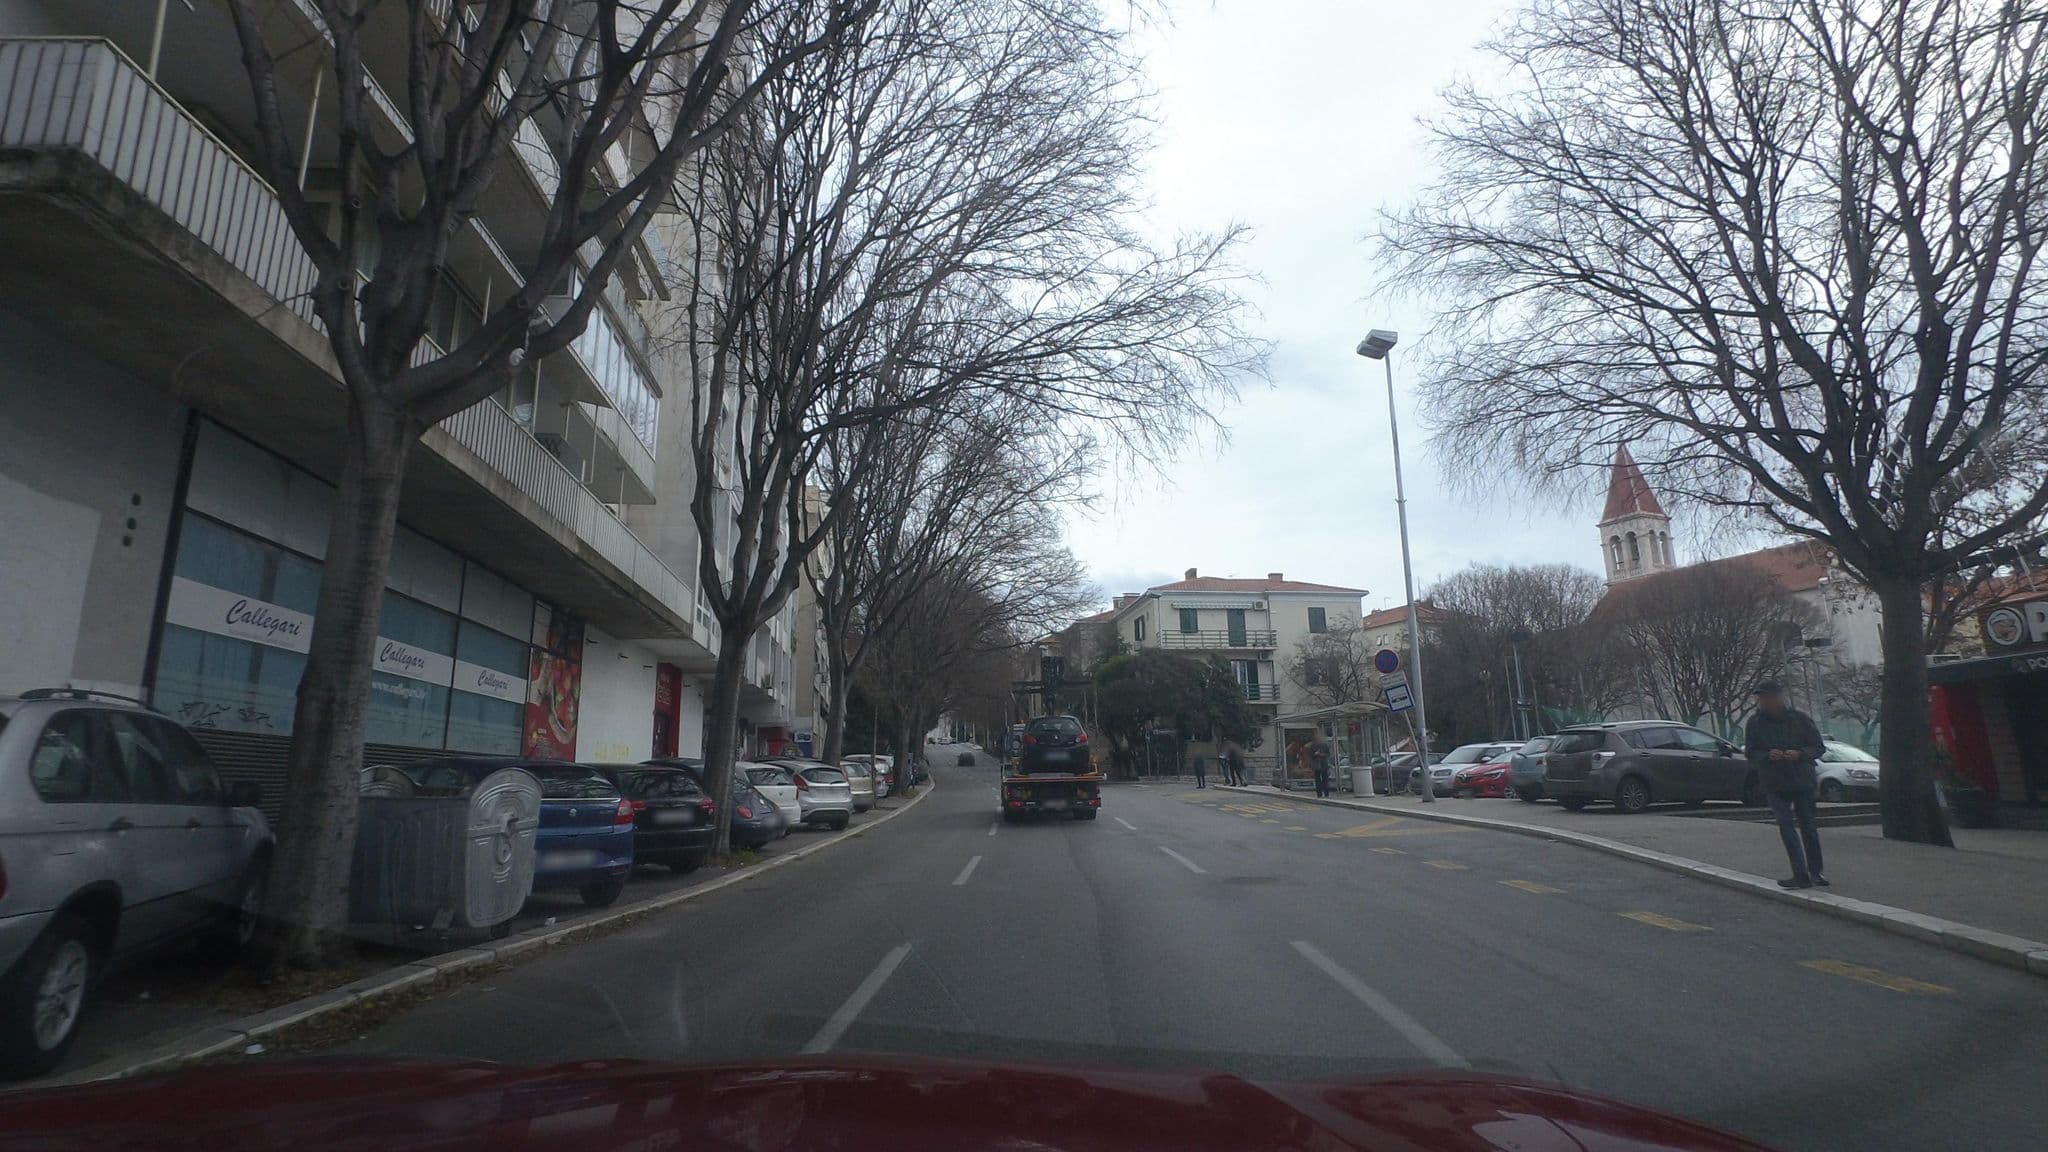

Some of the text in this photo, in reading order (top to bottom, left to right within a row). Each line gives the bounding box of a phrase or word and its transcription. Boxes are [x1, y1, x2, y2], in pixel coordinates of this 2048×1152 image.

[226, 599, 302, 636] Callegari
[379, 641, 426, 671] Callegari
[477, 669, 511, 692] Callegari
